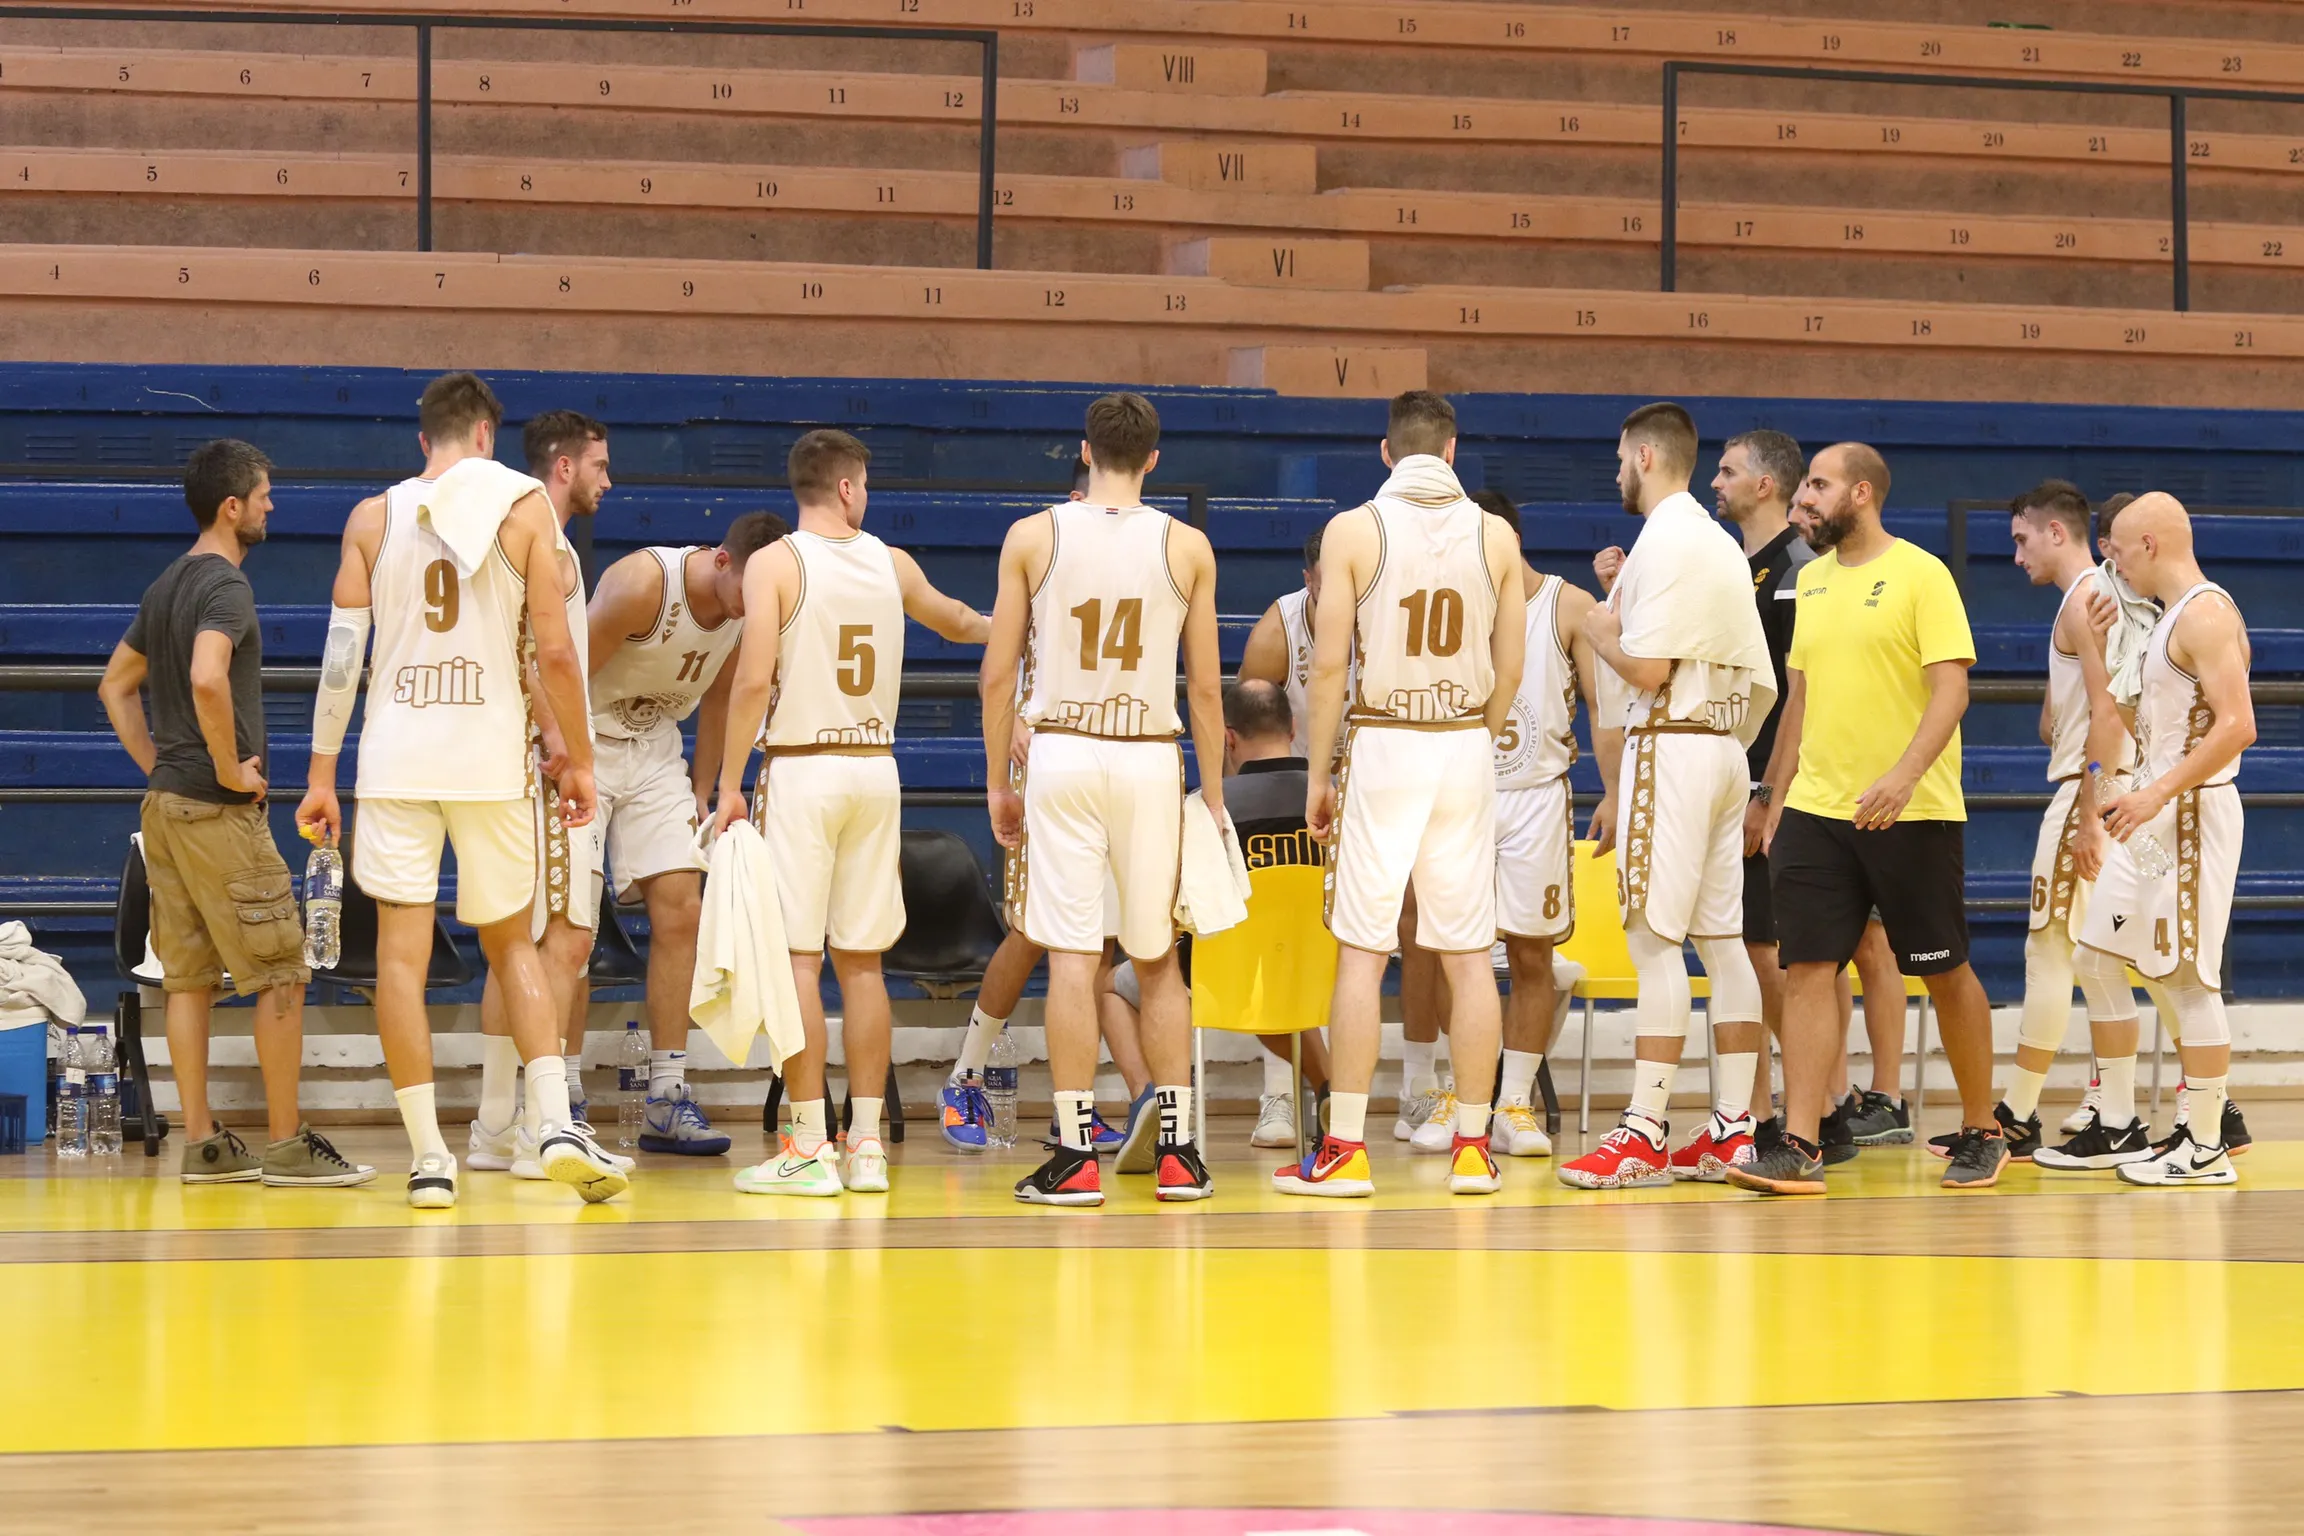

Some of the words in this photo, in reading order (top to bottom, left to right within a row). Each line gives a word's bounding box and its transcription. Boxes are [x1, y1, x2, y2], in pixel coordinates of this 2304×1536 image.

[1014, 1, 1034, 18] 13
[1288, 13, 1307, 29] 14
[1398, 18, 1417, 34] 15
[1506, 22, 1525, 38] 16
[1612, 26, 1630, 42] 17
[1717, 30, 1737, 46] 18
[1822, 35, 1841, 51] 19
[1921, 41, 1942, 57] 20
[2021, 46, 2041, 63] 21
[2121, 52, 2142, 68] 22
[1163, 54, 1194, 84] VIII
[2221, 56, 2242, 73] 23
[118, 66, 130, 82] 5
[239, 69, 251, 85] 6
[361, 72, 372, 88] 7
[478, 75, 491, 92] 8
[599, 79, 611, 96] 9
[712, 83, 732, 99] 10
[828, 87, 845, 104] 11
[945, 91, 964, 108] 12
[1060, 97, 1079, 114] 13
[1341, 111, 1360, 128] 14
[1453, 114, 1472, 130] 15
[1560, 116, 1580, 133] 16
[1777, 124, 1797, 140] 18
[1881, 127, 1901, 143] 19
[1983, 132, 2004, 148] 20
[2088, 136, 2107, 153] 21
[2190, 142, 2210, 157] 22
[18, 166, 30, 182] 4
[146, 165, 158, 182] 5
[1218, 153, 1244, 181] VII
[276, 168, 288, 185] 6
[398, 171, 409, 187] 7
[520, 174, 532, 191] 8
[640, 178, 652, 194] 9
[757, 181, 778, 198] 10
[878, 186, 894, 203] 11
[993, 190, 1013, 206] 12
[1113, 194, 1134, 211] 13
[1397, 207, 1417, 224] 14
[1511, 212, 1531, 229] 15
[1623, 216, 1642, 233] 16
[1735, 221, 1754, 237] 17
[1845, 225, 1864, 241] 18
[1950, 228, 1970, 245] 19
[2055, 232, 2076, 249] 20
[2262, 241, 2283, 257] 22
[1272, 248, 1294, 278] VI
[49, 264, 60, 280] 4
[178, 267, 190, 284] 5
[308, 269, 320, 286] 6
[434, 273, 446, 289] 7
[558, 275, 571, 293] 8
[682, 280, 694, 297] 9
[802, 282, 823, 299] 10
[925, 287, 941, 304] 11
[1046, 290, 1065, 307] 12
[1165, 294, 1186, 311] 13
[1459, 307, 1480, 324] 14
[1576, 310, 1597, 326] 15
[1688, 312, 1709, 329] 16
[1804, 315, 1824, 332] 17
[1911, 320, 1932, 336] 18
[2020, 323, 2041, 340] 19
[2124, 328, 2146, 344] 20
[2234, 331, 2253, 348] 21
[1335, 357, 1348, 387] V
[424, 558, 460, 634] 9
[1398, 587, 1465, 658] 10
[1070, 597, 1144, 672] 14
[675, 649, 711, 683] 11
[836, 624, 876, 697] 5
[394, 655, 486, 709] split
[1495, 719, 1521, 752] 5
[1542, 883, 1561, 920] 8
[2032, 875, 2049, 913] 6
[2154, 917, 2173, 957] 4
[1909, 948, 1951, 962] macron
[1320, 1143, 1342, 1165] 15
